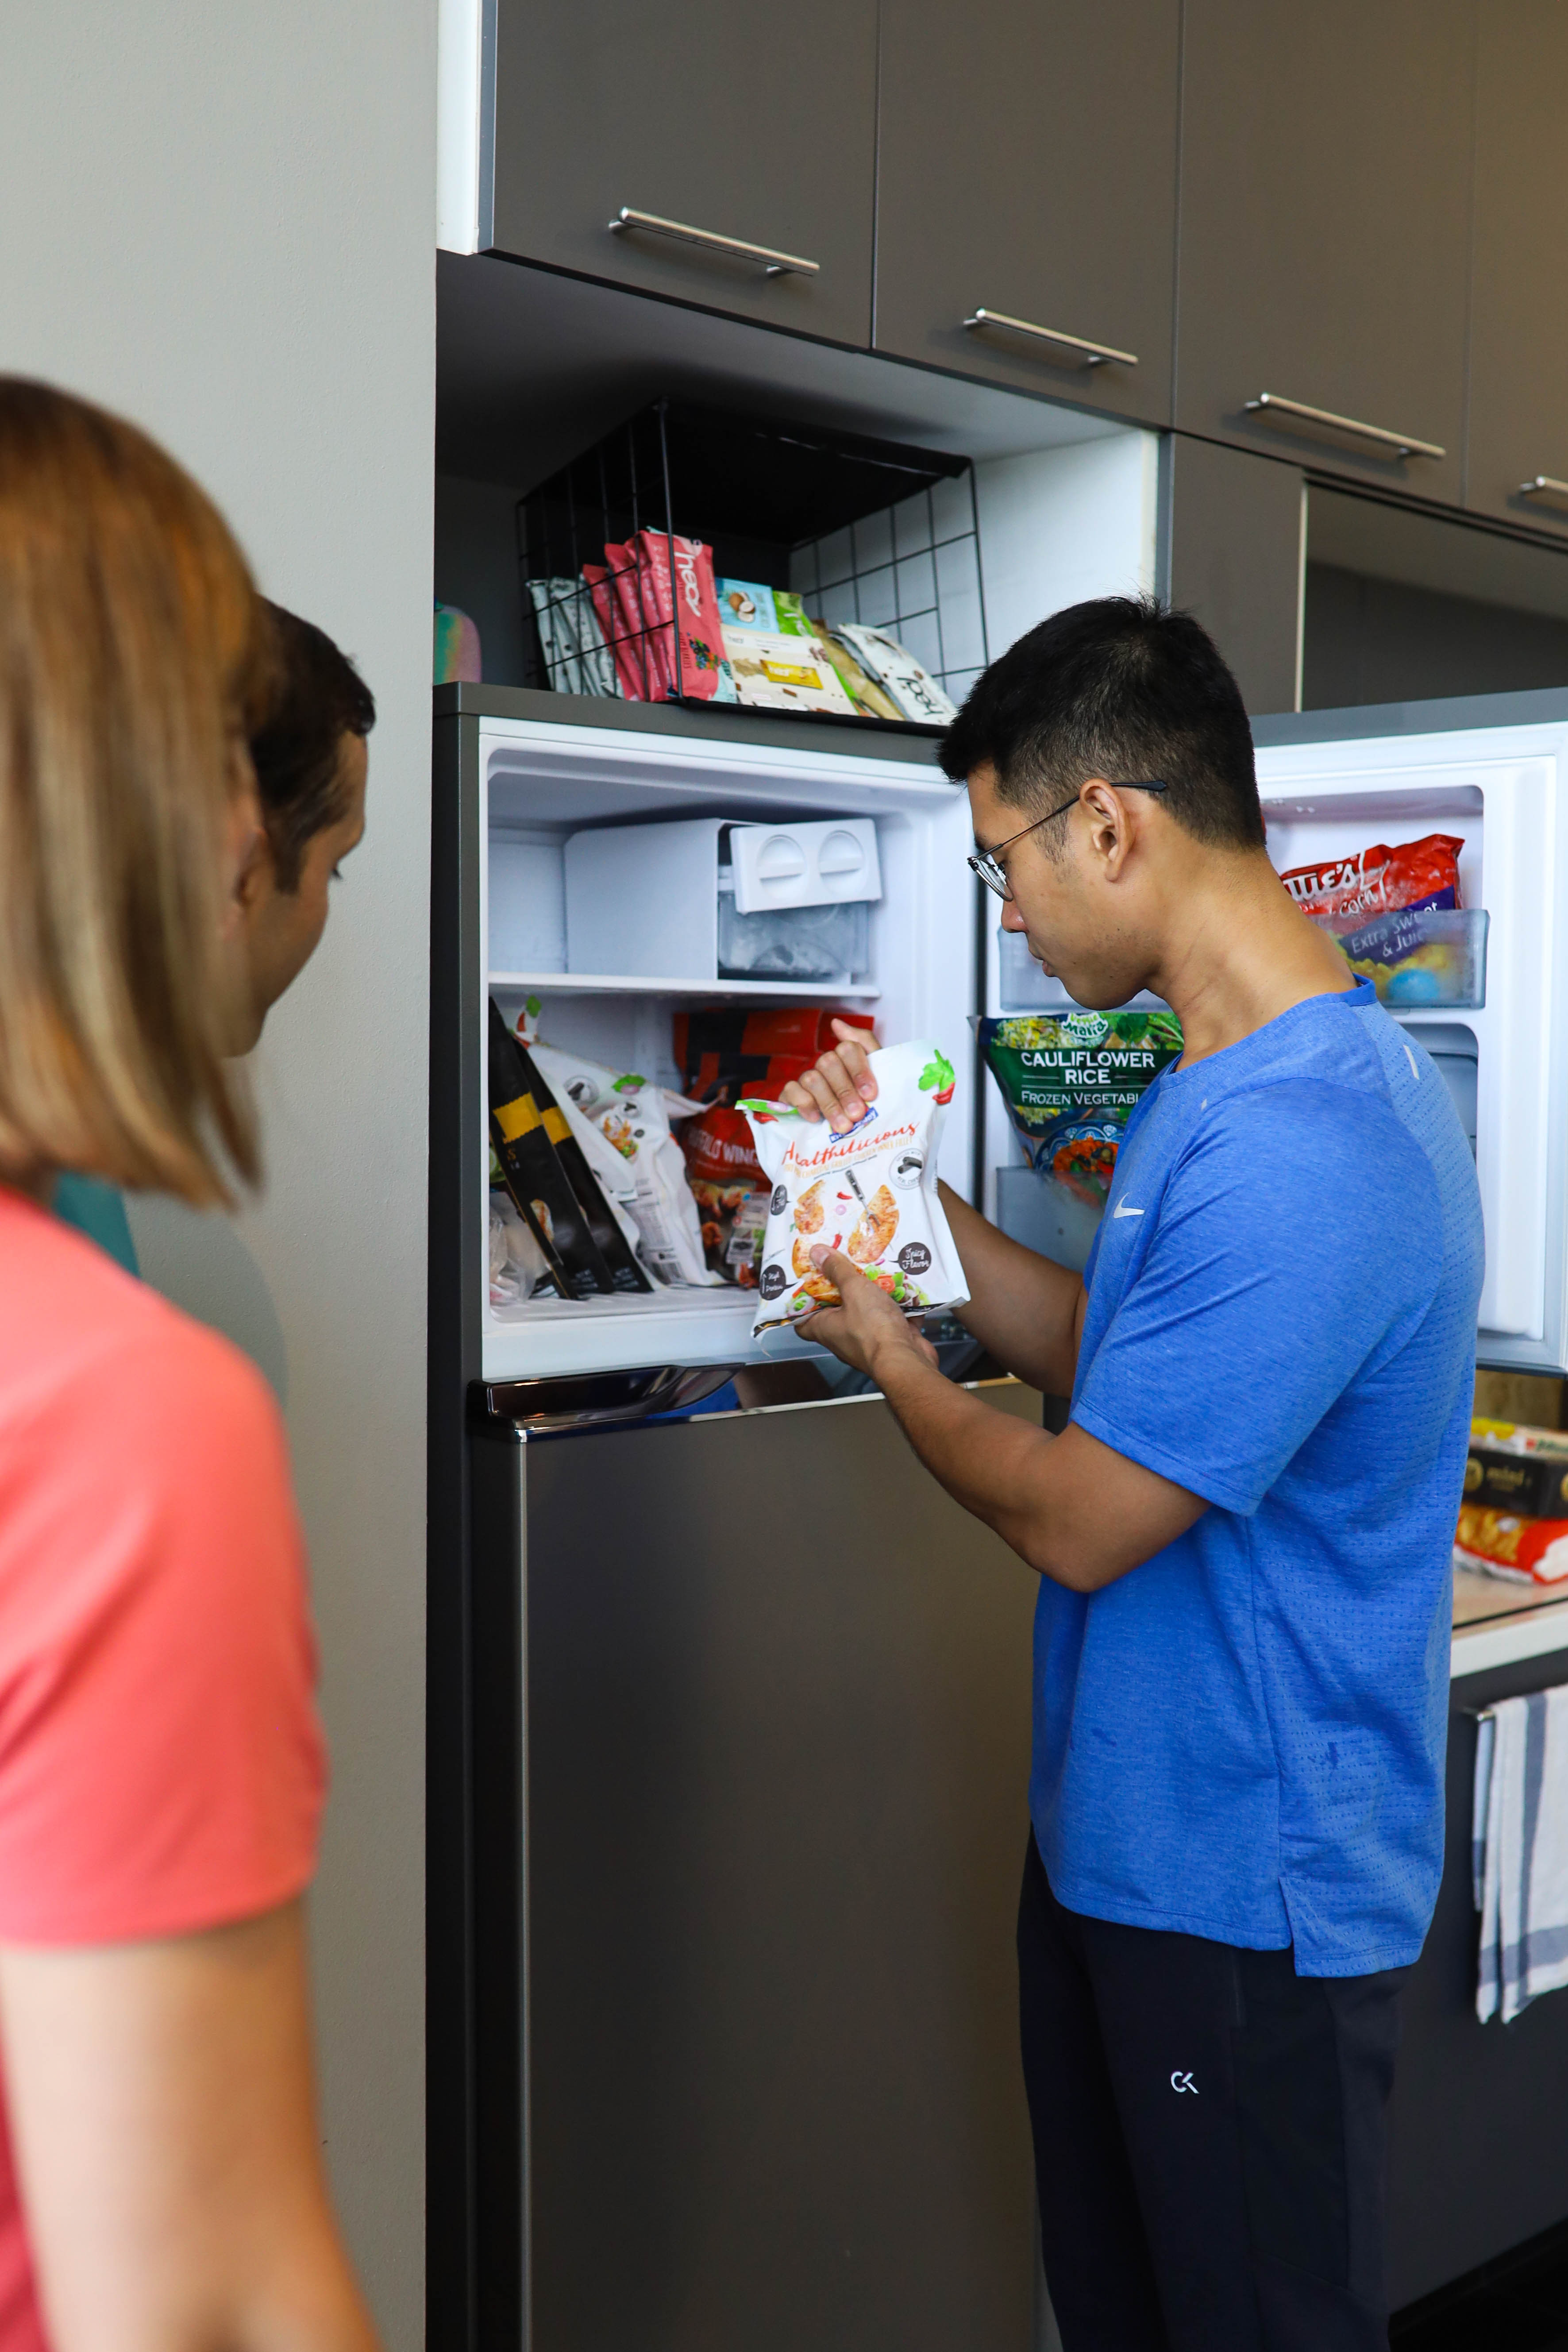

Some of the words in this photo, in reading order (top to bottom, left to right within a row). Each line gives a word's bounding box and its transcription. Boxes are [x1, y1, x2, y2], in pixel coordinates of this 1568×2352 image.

[1383, 941, 1393, 958] &
[1021, 1051, 1156, 1068] CAULIFLOWER
[1065, 1068, 1111, 1084] RICE
[1073, 1091, 1139, 1105] VEGETABL
[1171, 2071, 1200, 2094] CK
